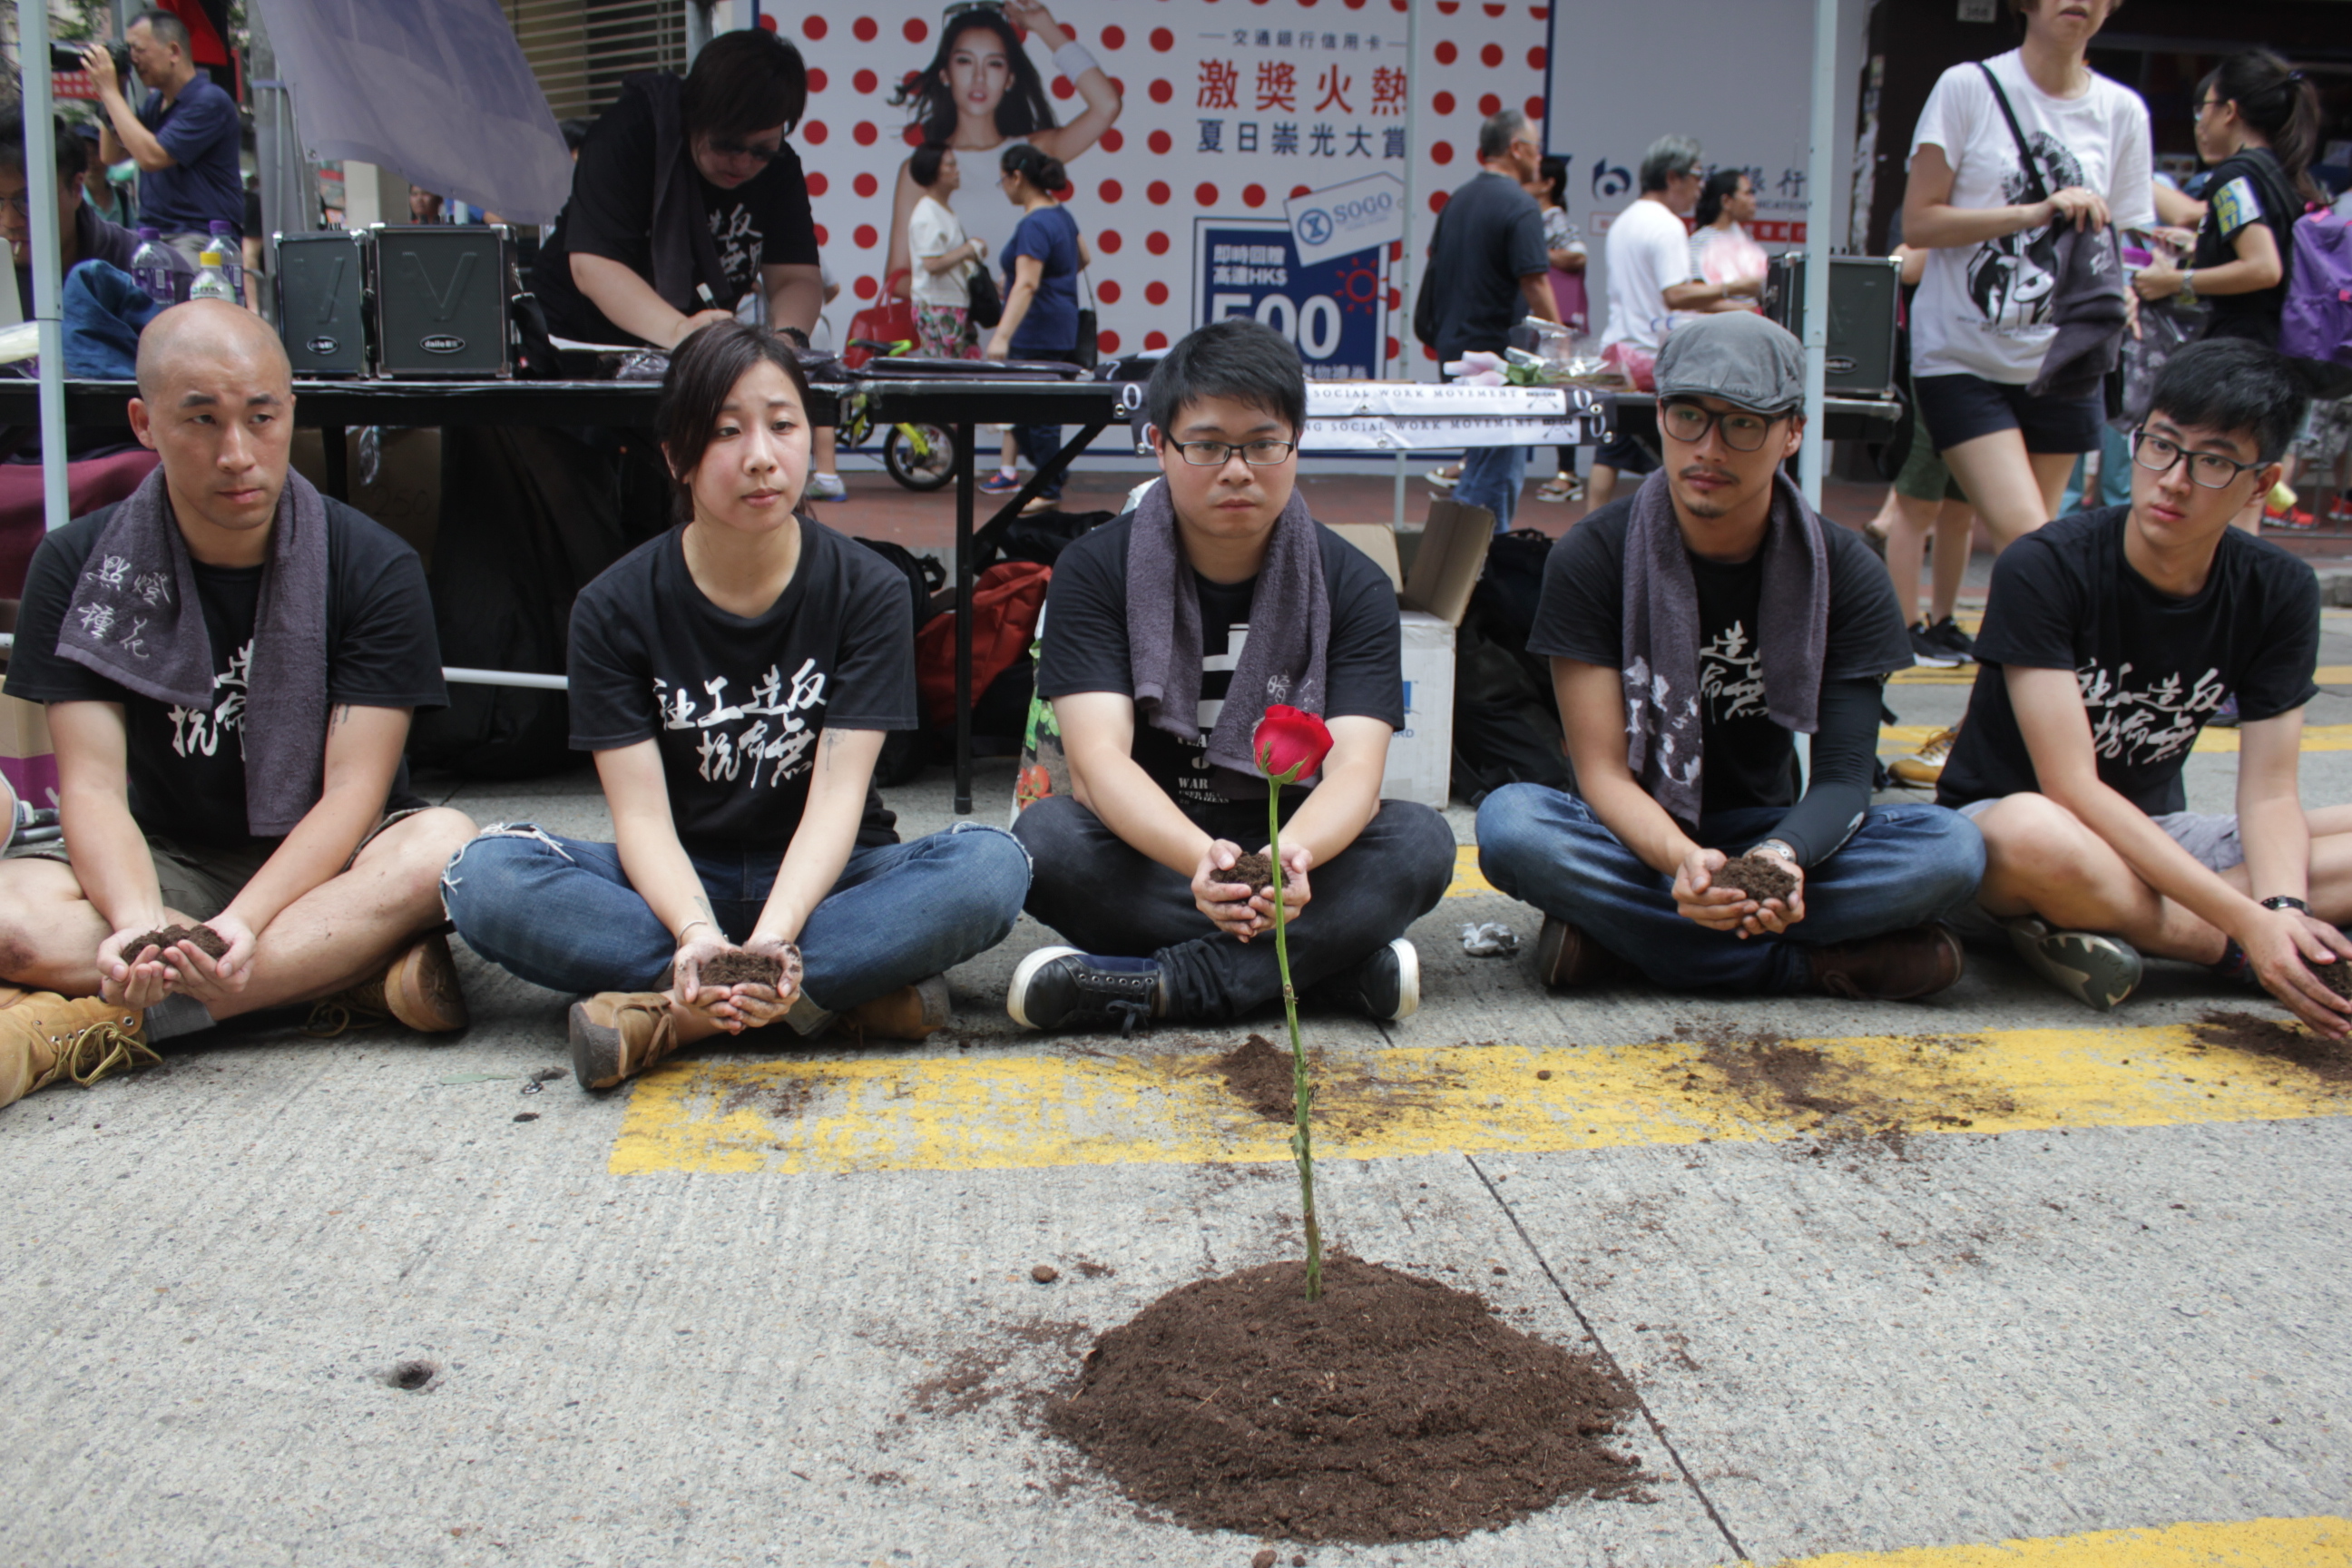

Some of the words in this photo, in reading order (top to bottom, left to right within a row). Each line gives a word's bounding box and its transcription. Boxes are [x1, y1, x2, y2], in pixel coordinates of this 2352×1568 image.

[1231, 28, 1382, 52] 交通銀行信用卡
[1196, 57, 1407, 116] 激獎火熱
[1196, 117, 1406, 160] 夏日崇光大賞
[1333, 191, 1393, 225] SOGO
[1313, 388, 1370, 398] SOCIAL
[1377, 388, 1425, 398] WORK
[1434, 388, 1519, 398] MOVEMENT
[1330, 420, 1387, 431] SOCIAL
[1395, 420, 1442, 430] WORK
[1450, 417, 1534, 429] MOVEMENT
[1392, 729, 1415, 739] RD
